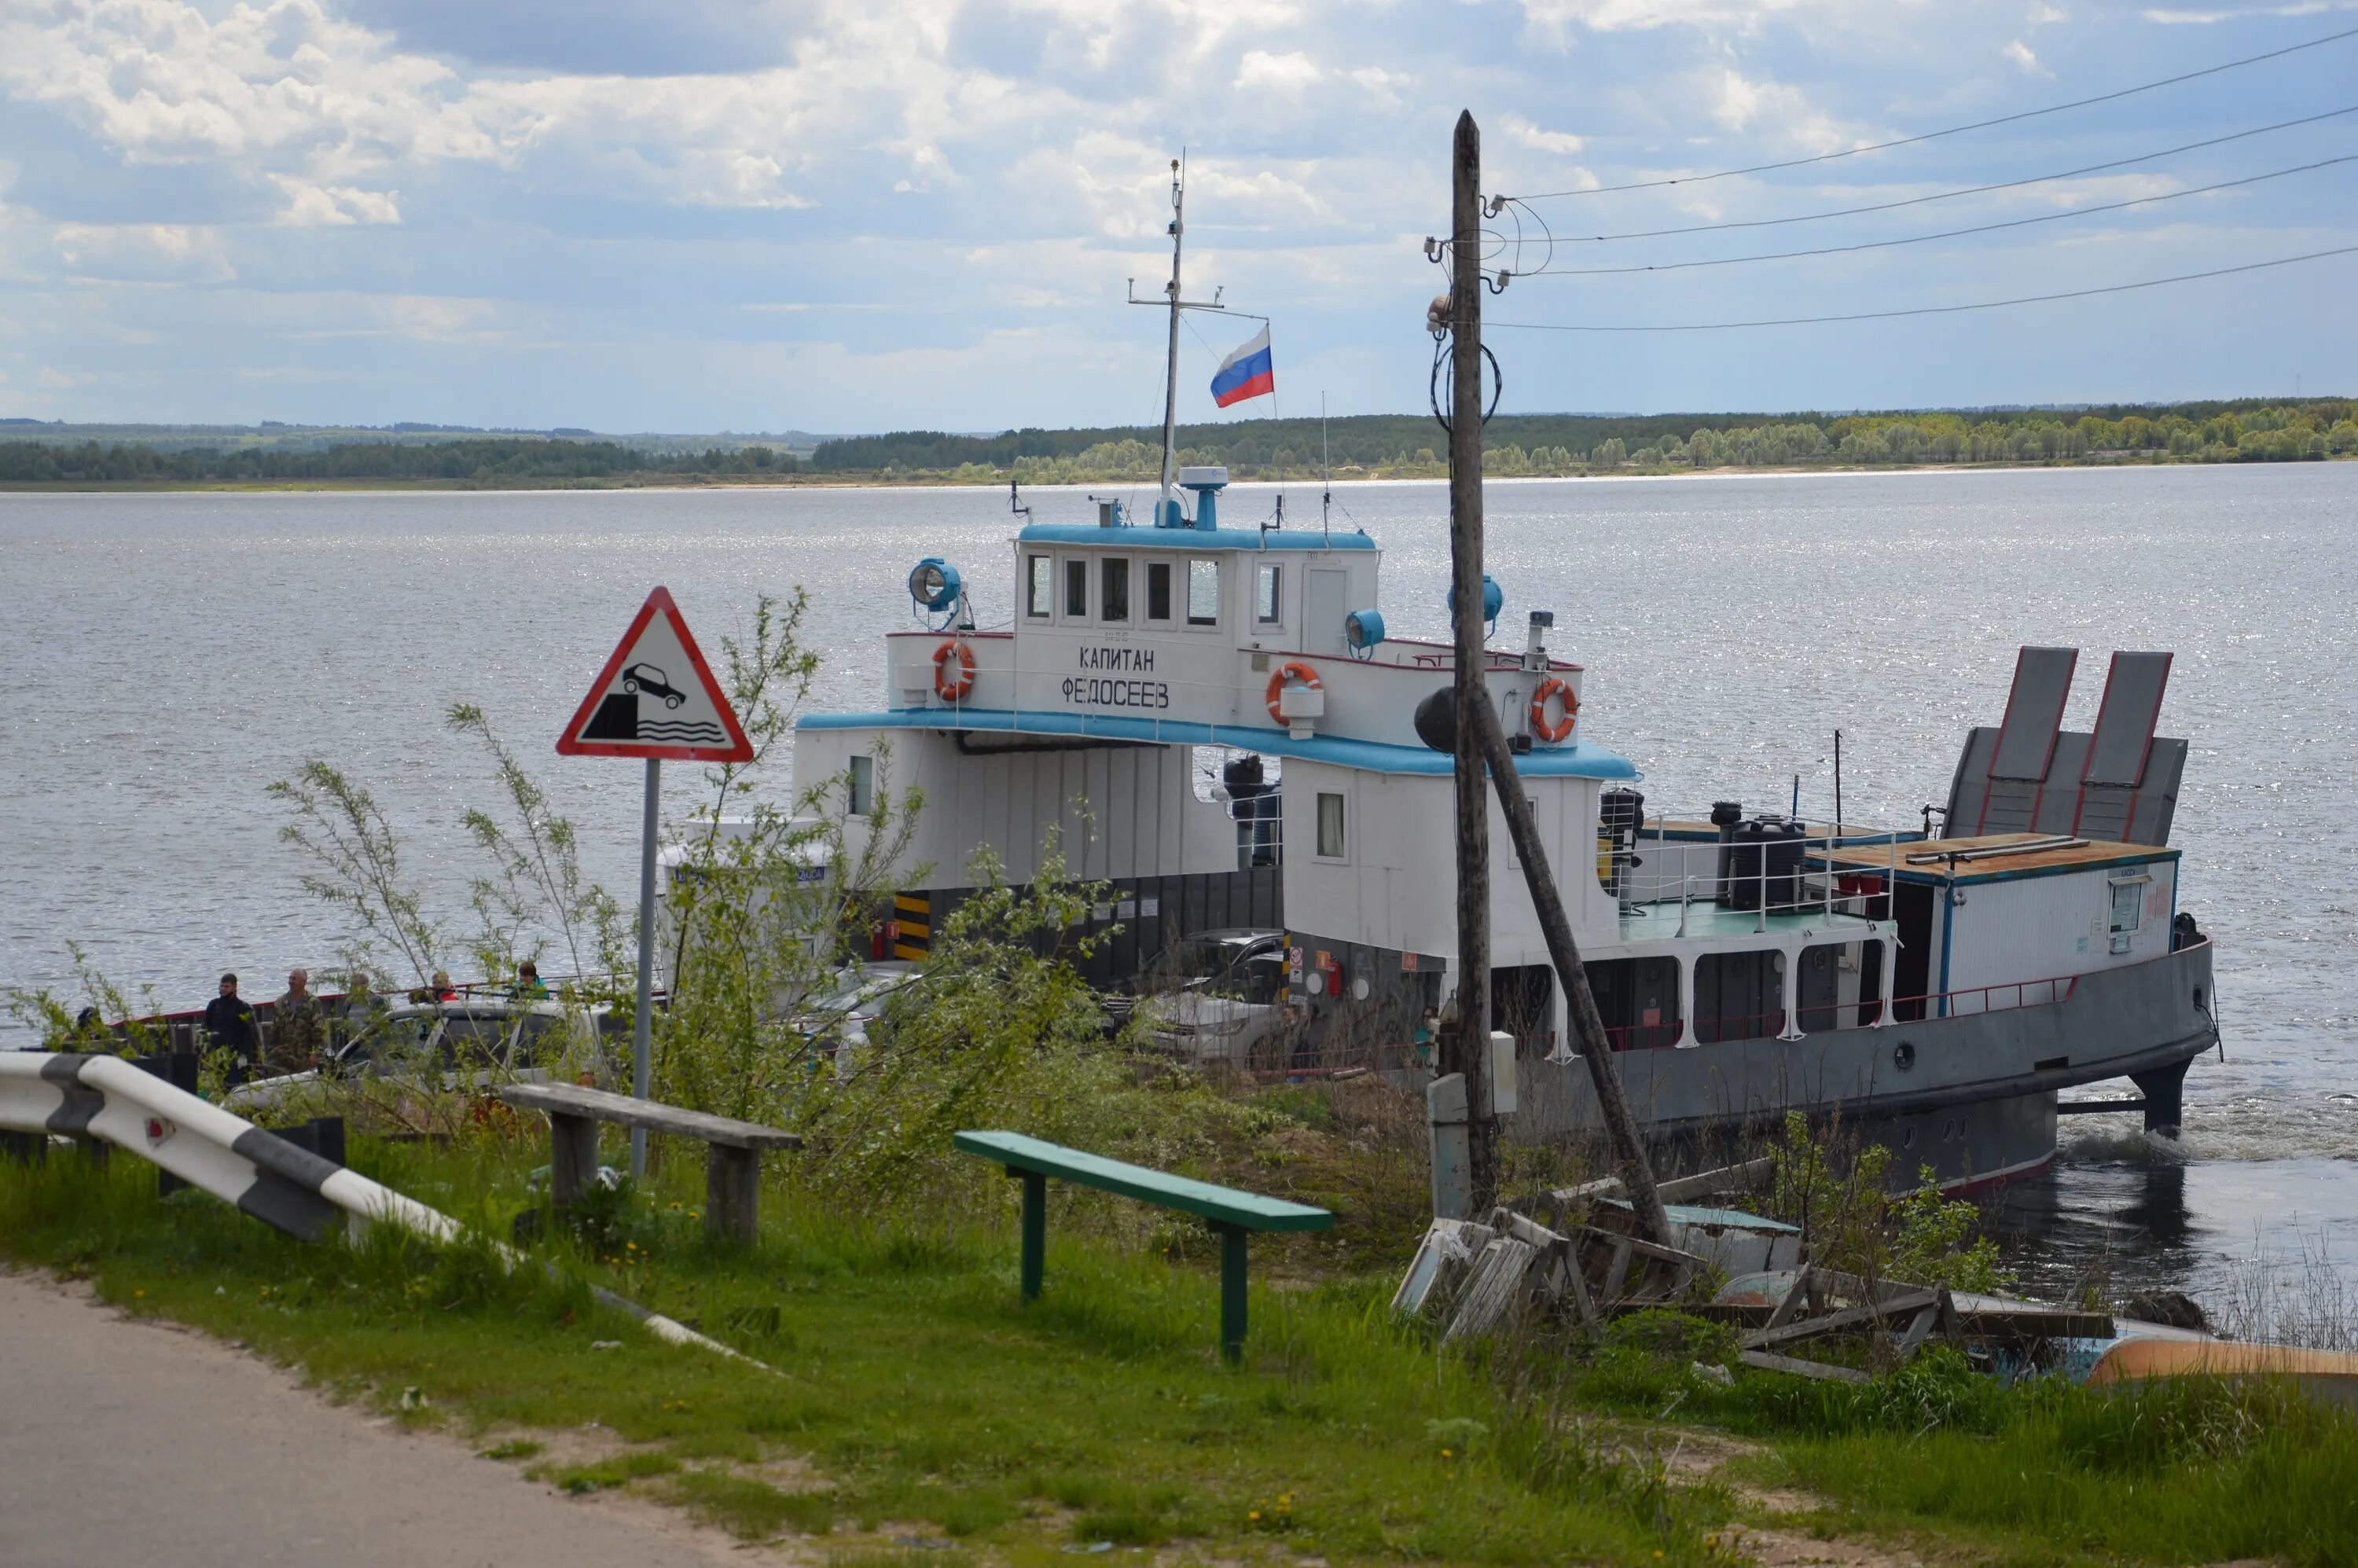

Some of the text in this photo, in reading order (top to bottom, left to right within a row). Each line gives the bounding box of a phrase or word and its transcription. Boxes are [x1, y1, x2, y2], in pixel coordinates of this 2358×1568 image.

[1079, 647, 1155, 672] КАПИТАН
[1061, 677, 1170, 709] ФЕДОСЕЕВ
[2121, 868, 2136, 877] КАССА
